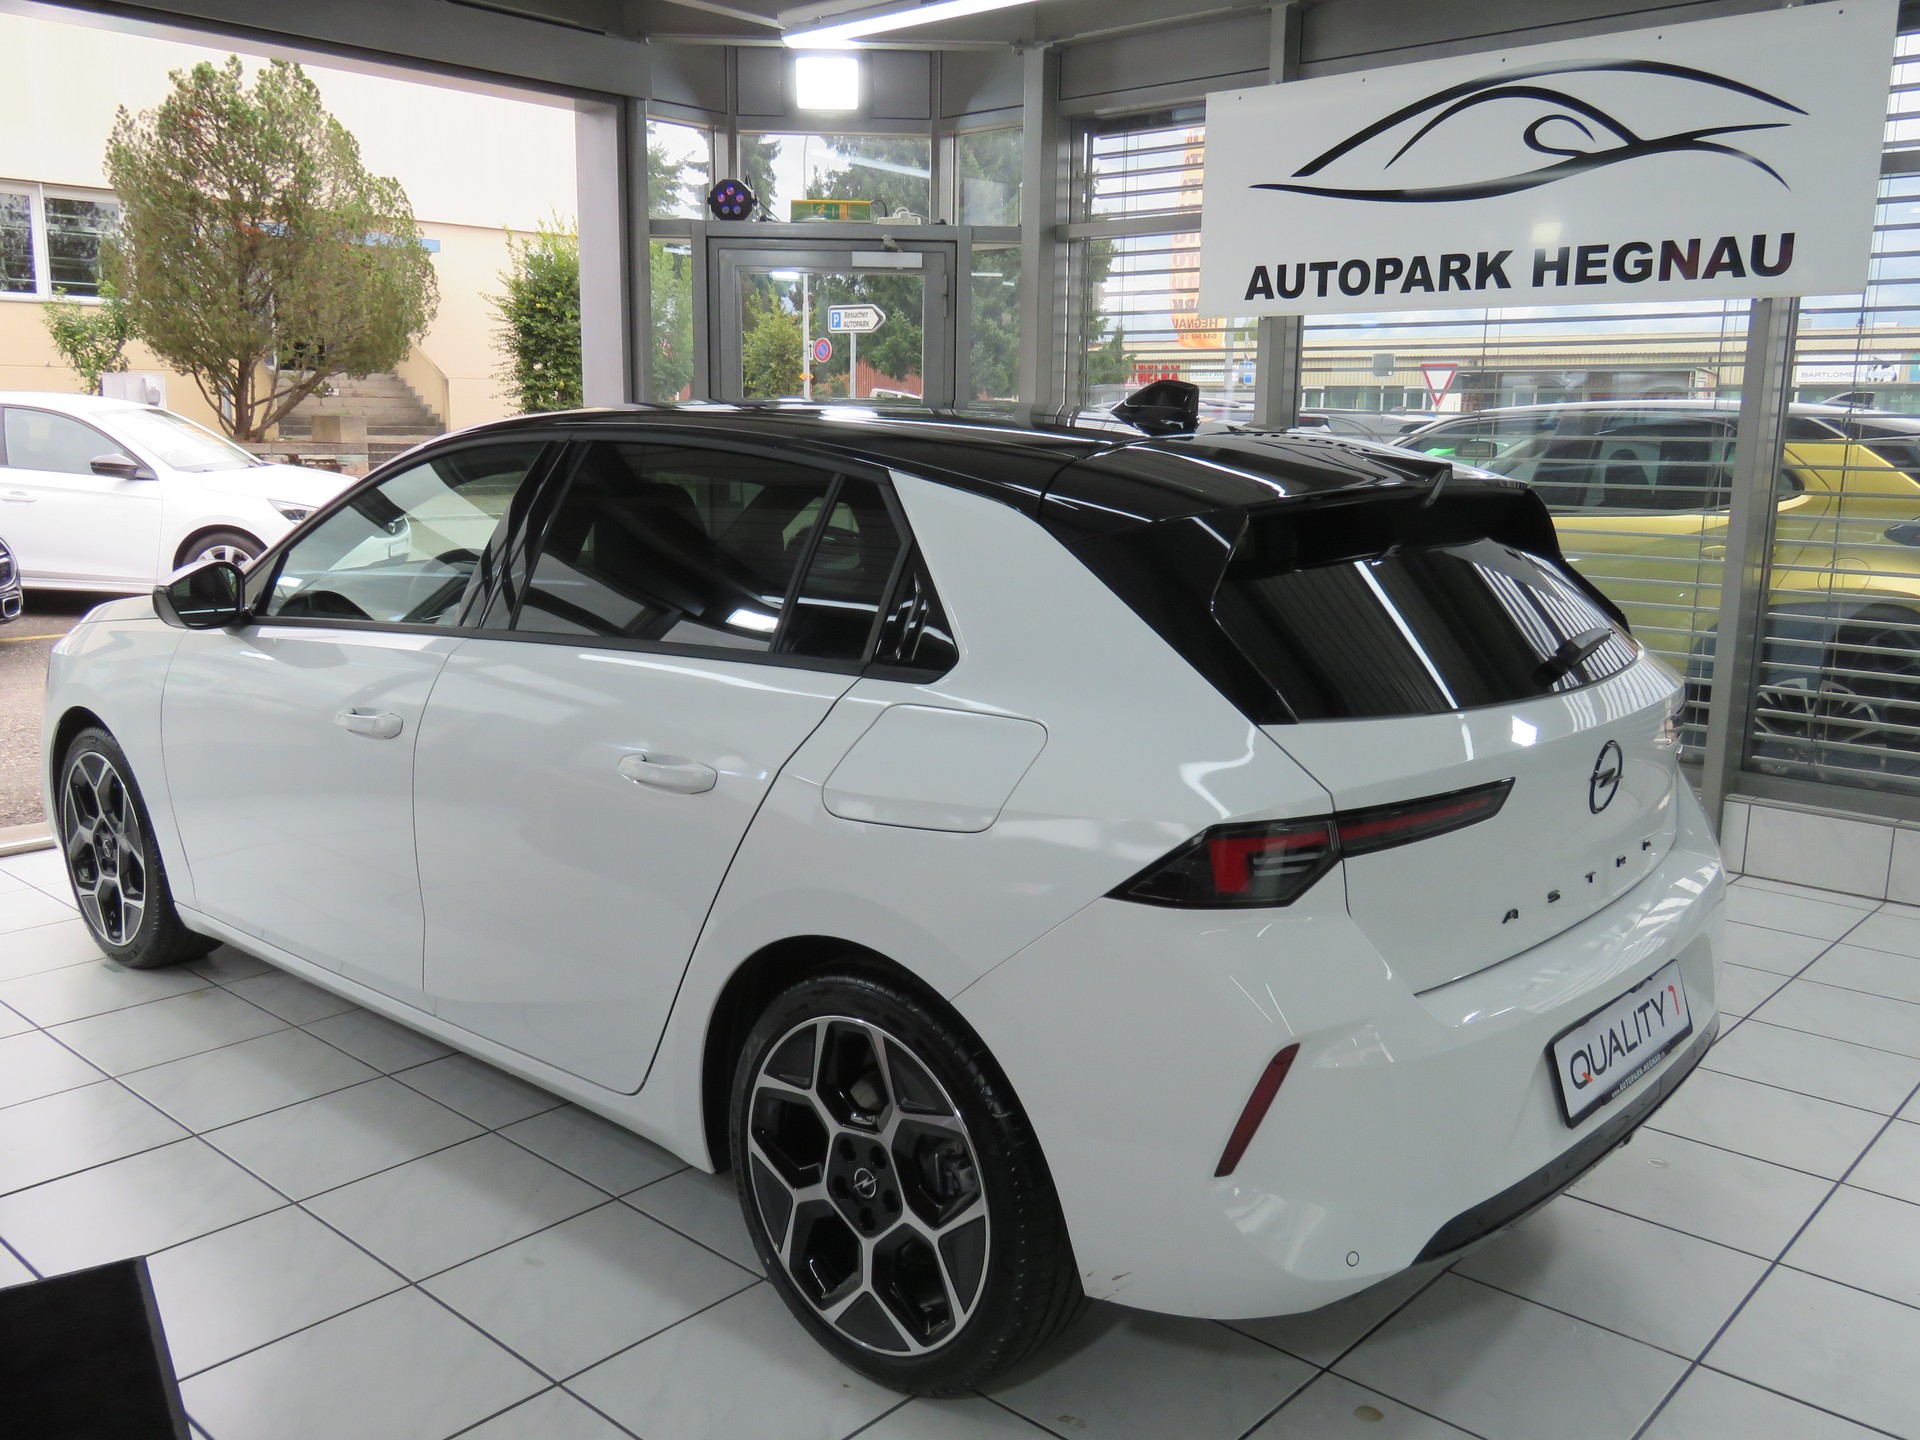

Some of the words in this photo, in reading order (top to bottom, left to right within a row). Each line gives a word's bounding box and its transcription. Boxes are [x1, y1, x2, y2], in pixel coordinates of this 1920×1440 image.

[1244, 249, 1514, 300] AUTOPARK
[1532, 232, 1796, 287] HEGNAU
[844, 311, 869, 319] Besucher
[1502, 839, 1652, 924] ASTRA
